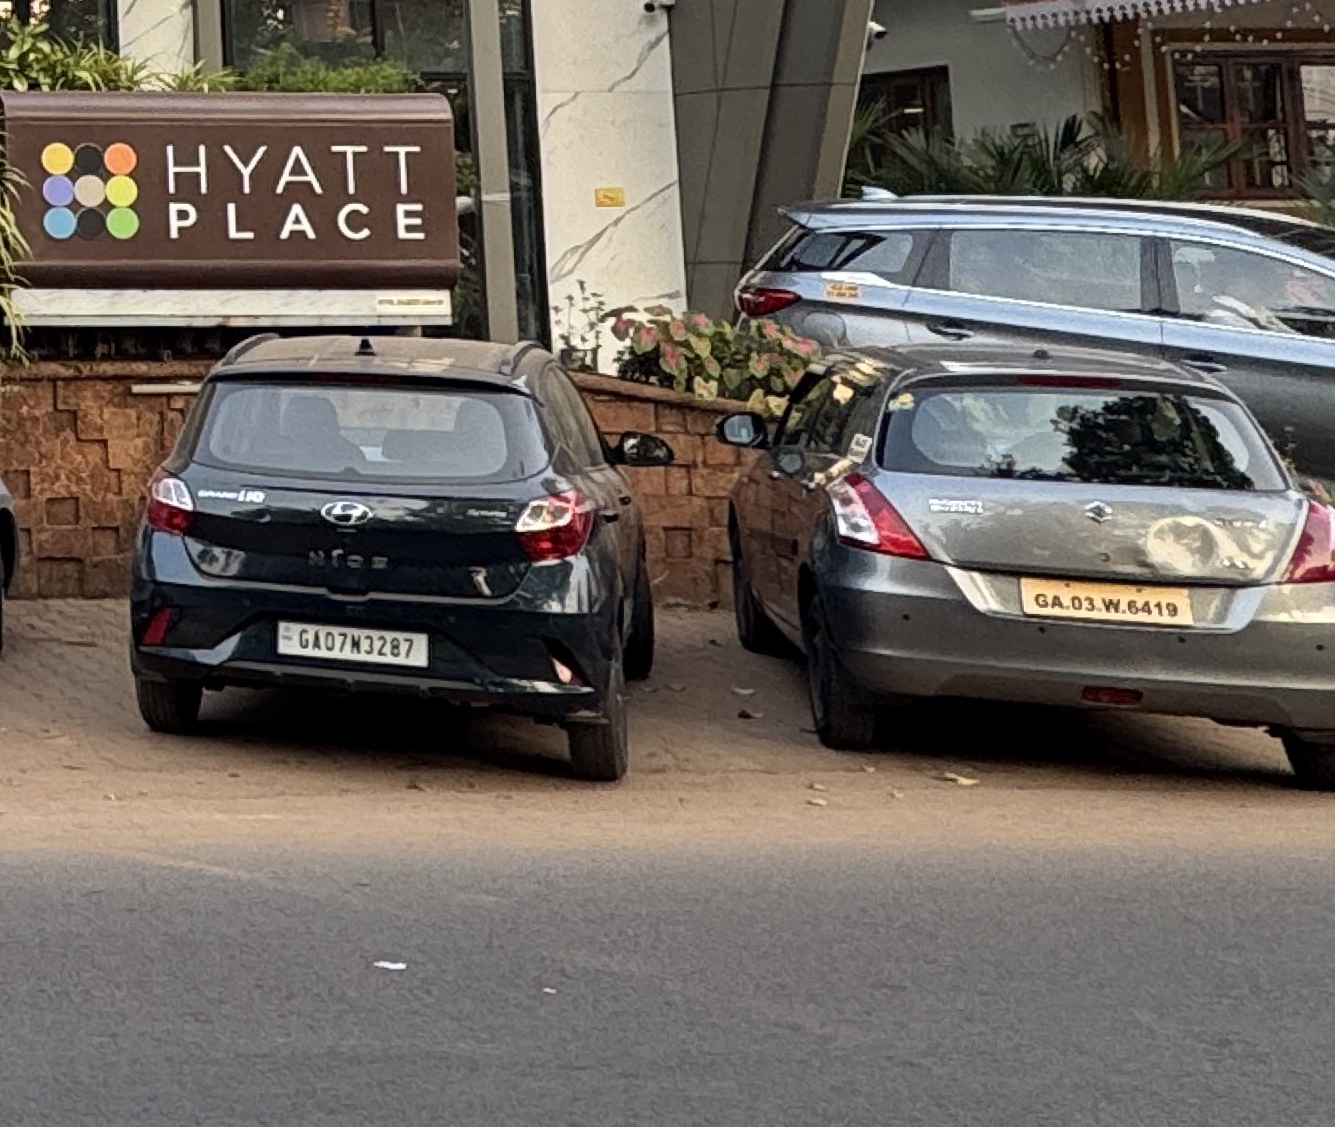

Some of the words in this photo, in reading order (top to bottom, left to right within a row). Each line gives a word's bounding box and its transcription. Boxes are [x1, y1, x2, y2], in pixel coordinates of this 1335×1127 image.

[166, 144, 421, 195] HYATT
[168, 201, 425, 240] PLACE
[298, 628, 414, 660] GA07N3287
